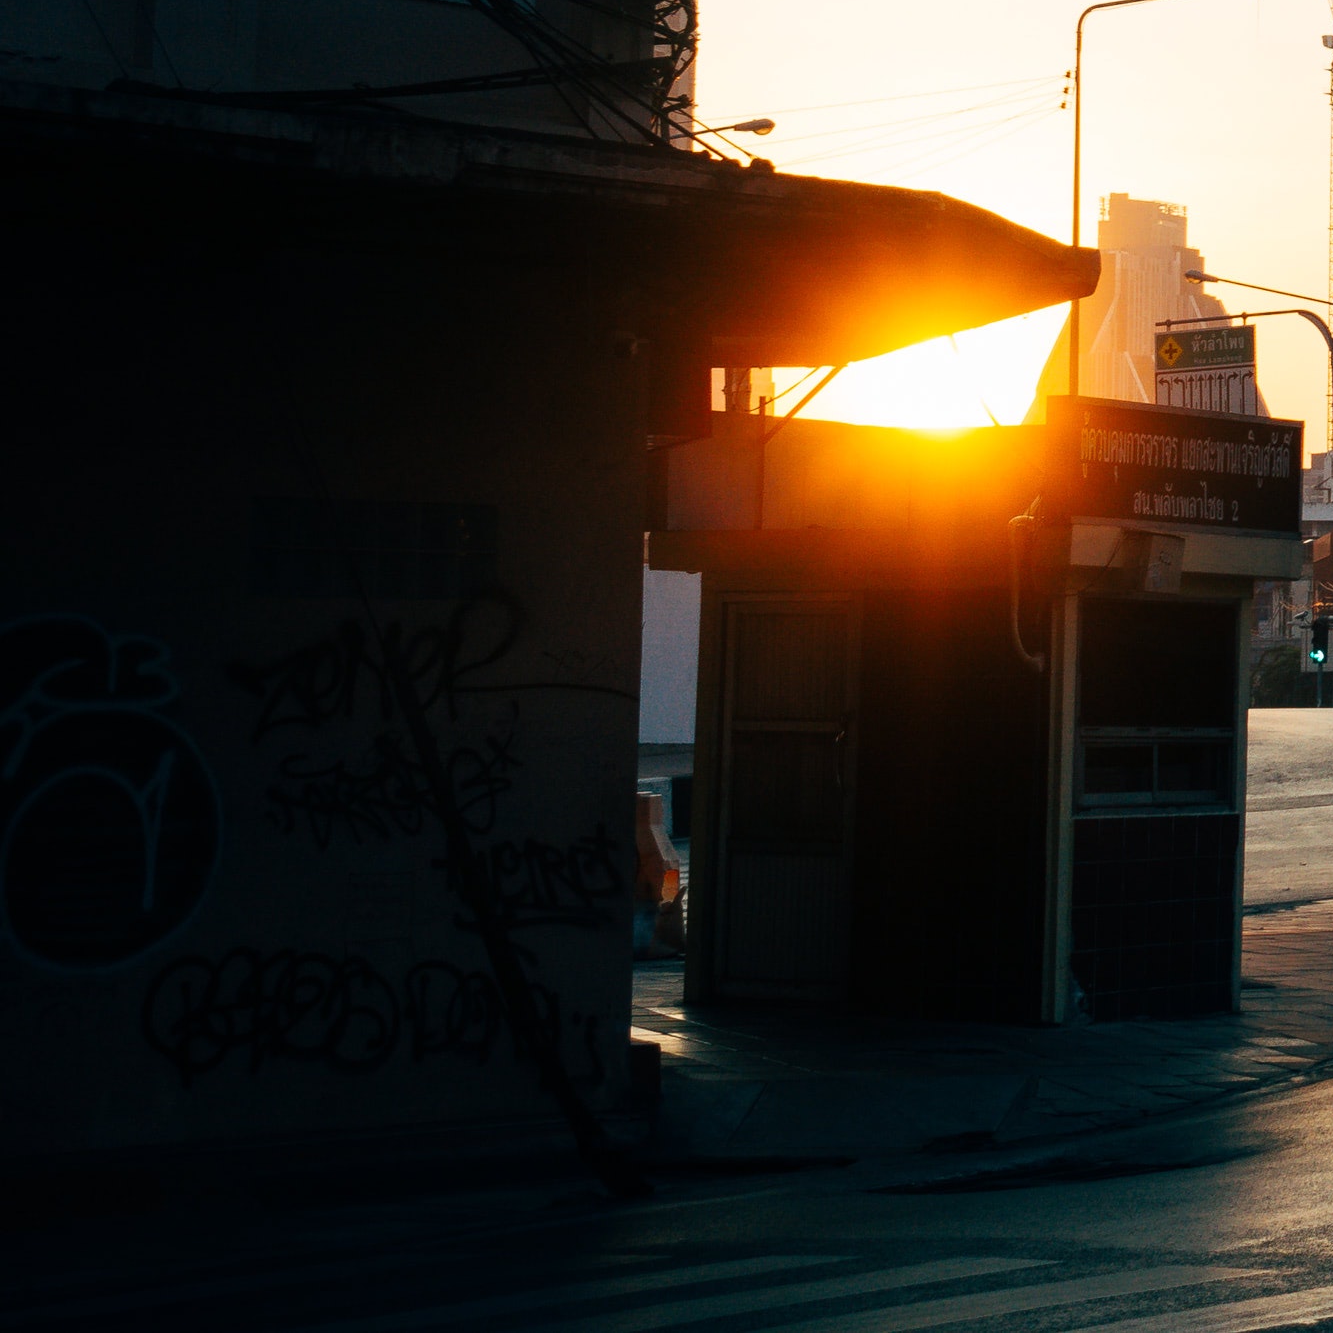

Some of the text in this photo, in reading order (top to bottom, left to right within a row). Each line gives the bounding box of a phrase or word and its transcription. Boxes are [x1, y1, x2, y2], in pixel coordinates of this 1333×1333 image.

[1191, 331, 1245, 353] หัวลำโพง
[1231, 500, 1239, 522] 2
